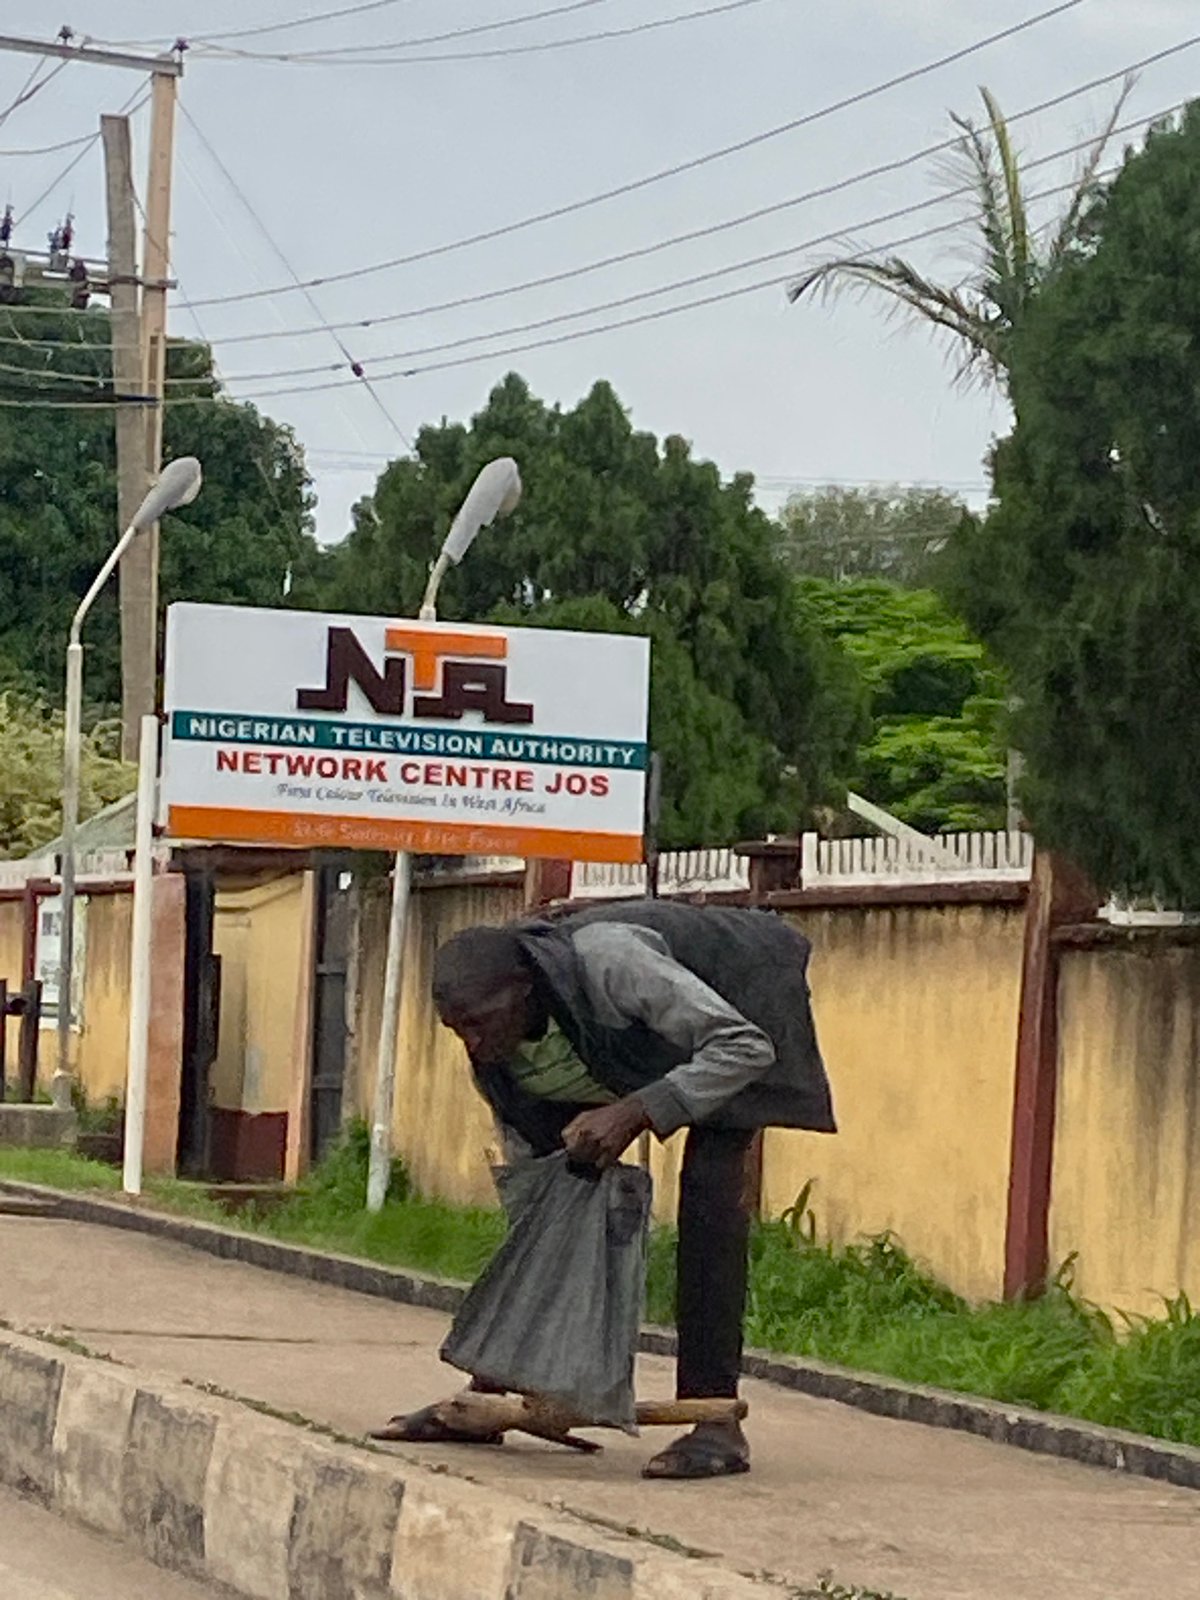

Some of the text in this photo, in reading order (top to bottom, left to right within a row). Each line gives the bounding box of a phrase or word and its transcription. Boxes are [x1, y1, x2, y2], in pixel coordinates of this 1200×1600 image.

[297, 626, 533, 723] NTA
[190, 718, 636, 765] NIGERIAN TELEVISION AUTHORITY
[217, 750, 609, 796] NETWORK CENTRE JOS
[499, 796, 546, 816] Africa
